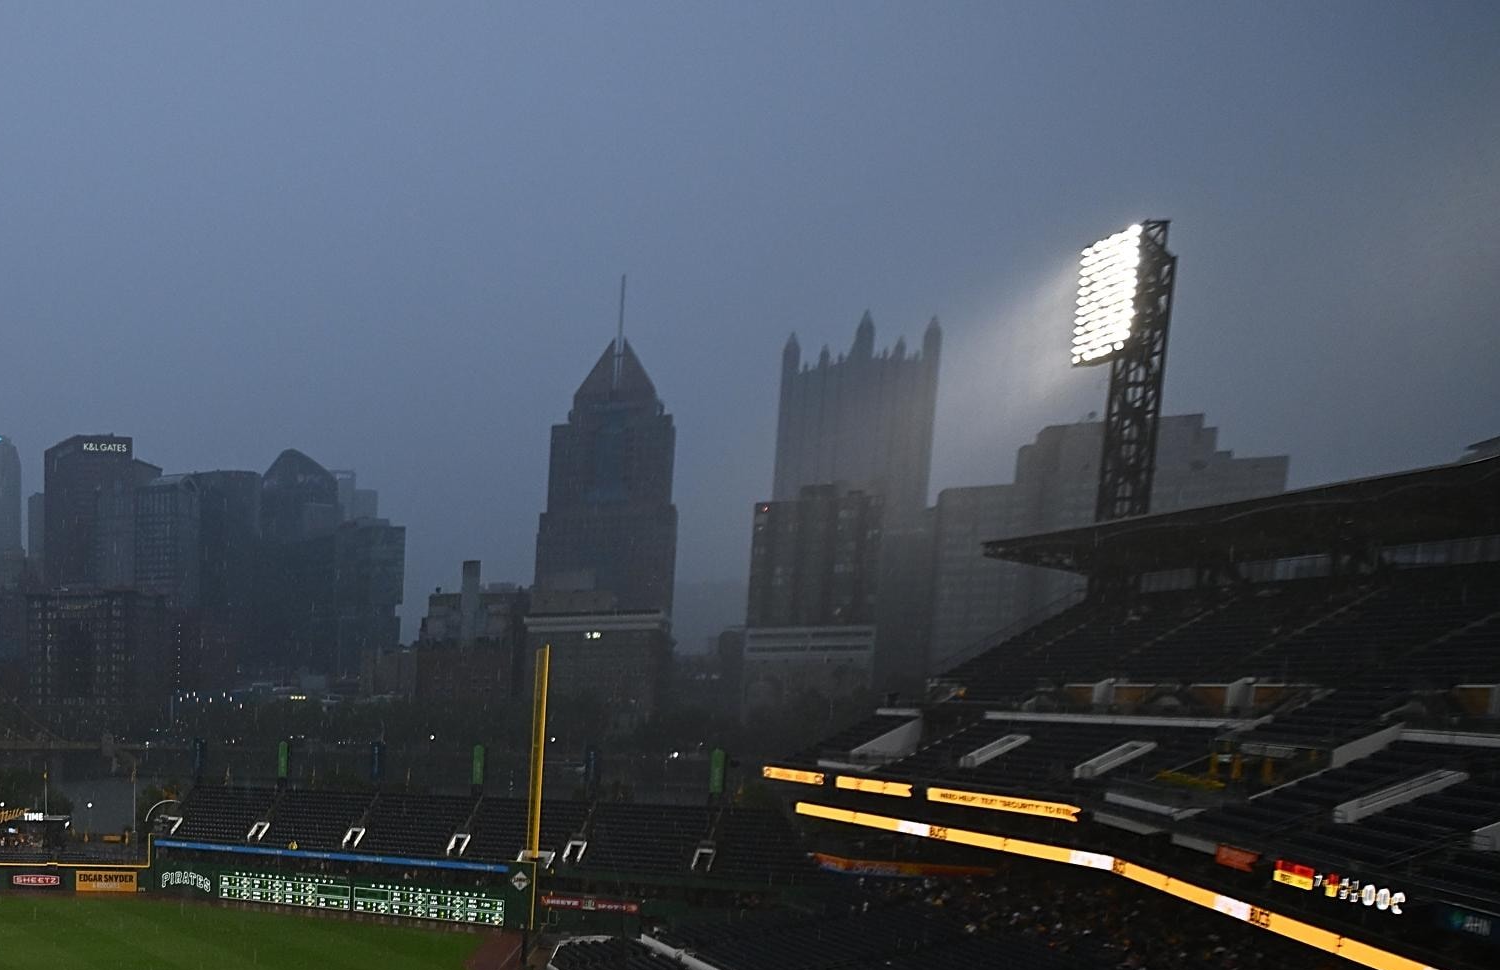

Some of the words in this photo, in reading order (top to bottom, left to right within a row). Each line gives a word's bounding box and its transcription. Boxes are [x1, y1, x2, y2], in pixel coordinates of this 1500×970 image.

[83, 443, 99, 452] K&L
[100, 443, 127, 453] GATES
[24, 812, 44, 821] TIME
[78, 873, 103, 882] EDGAR
[104, 874, 134, 883] SNYDER
[161, 871, 211, 893] PIRATES
